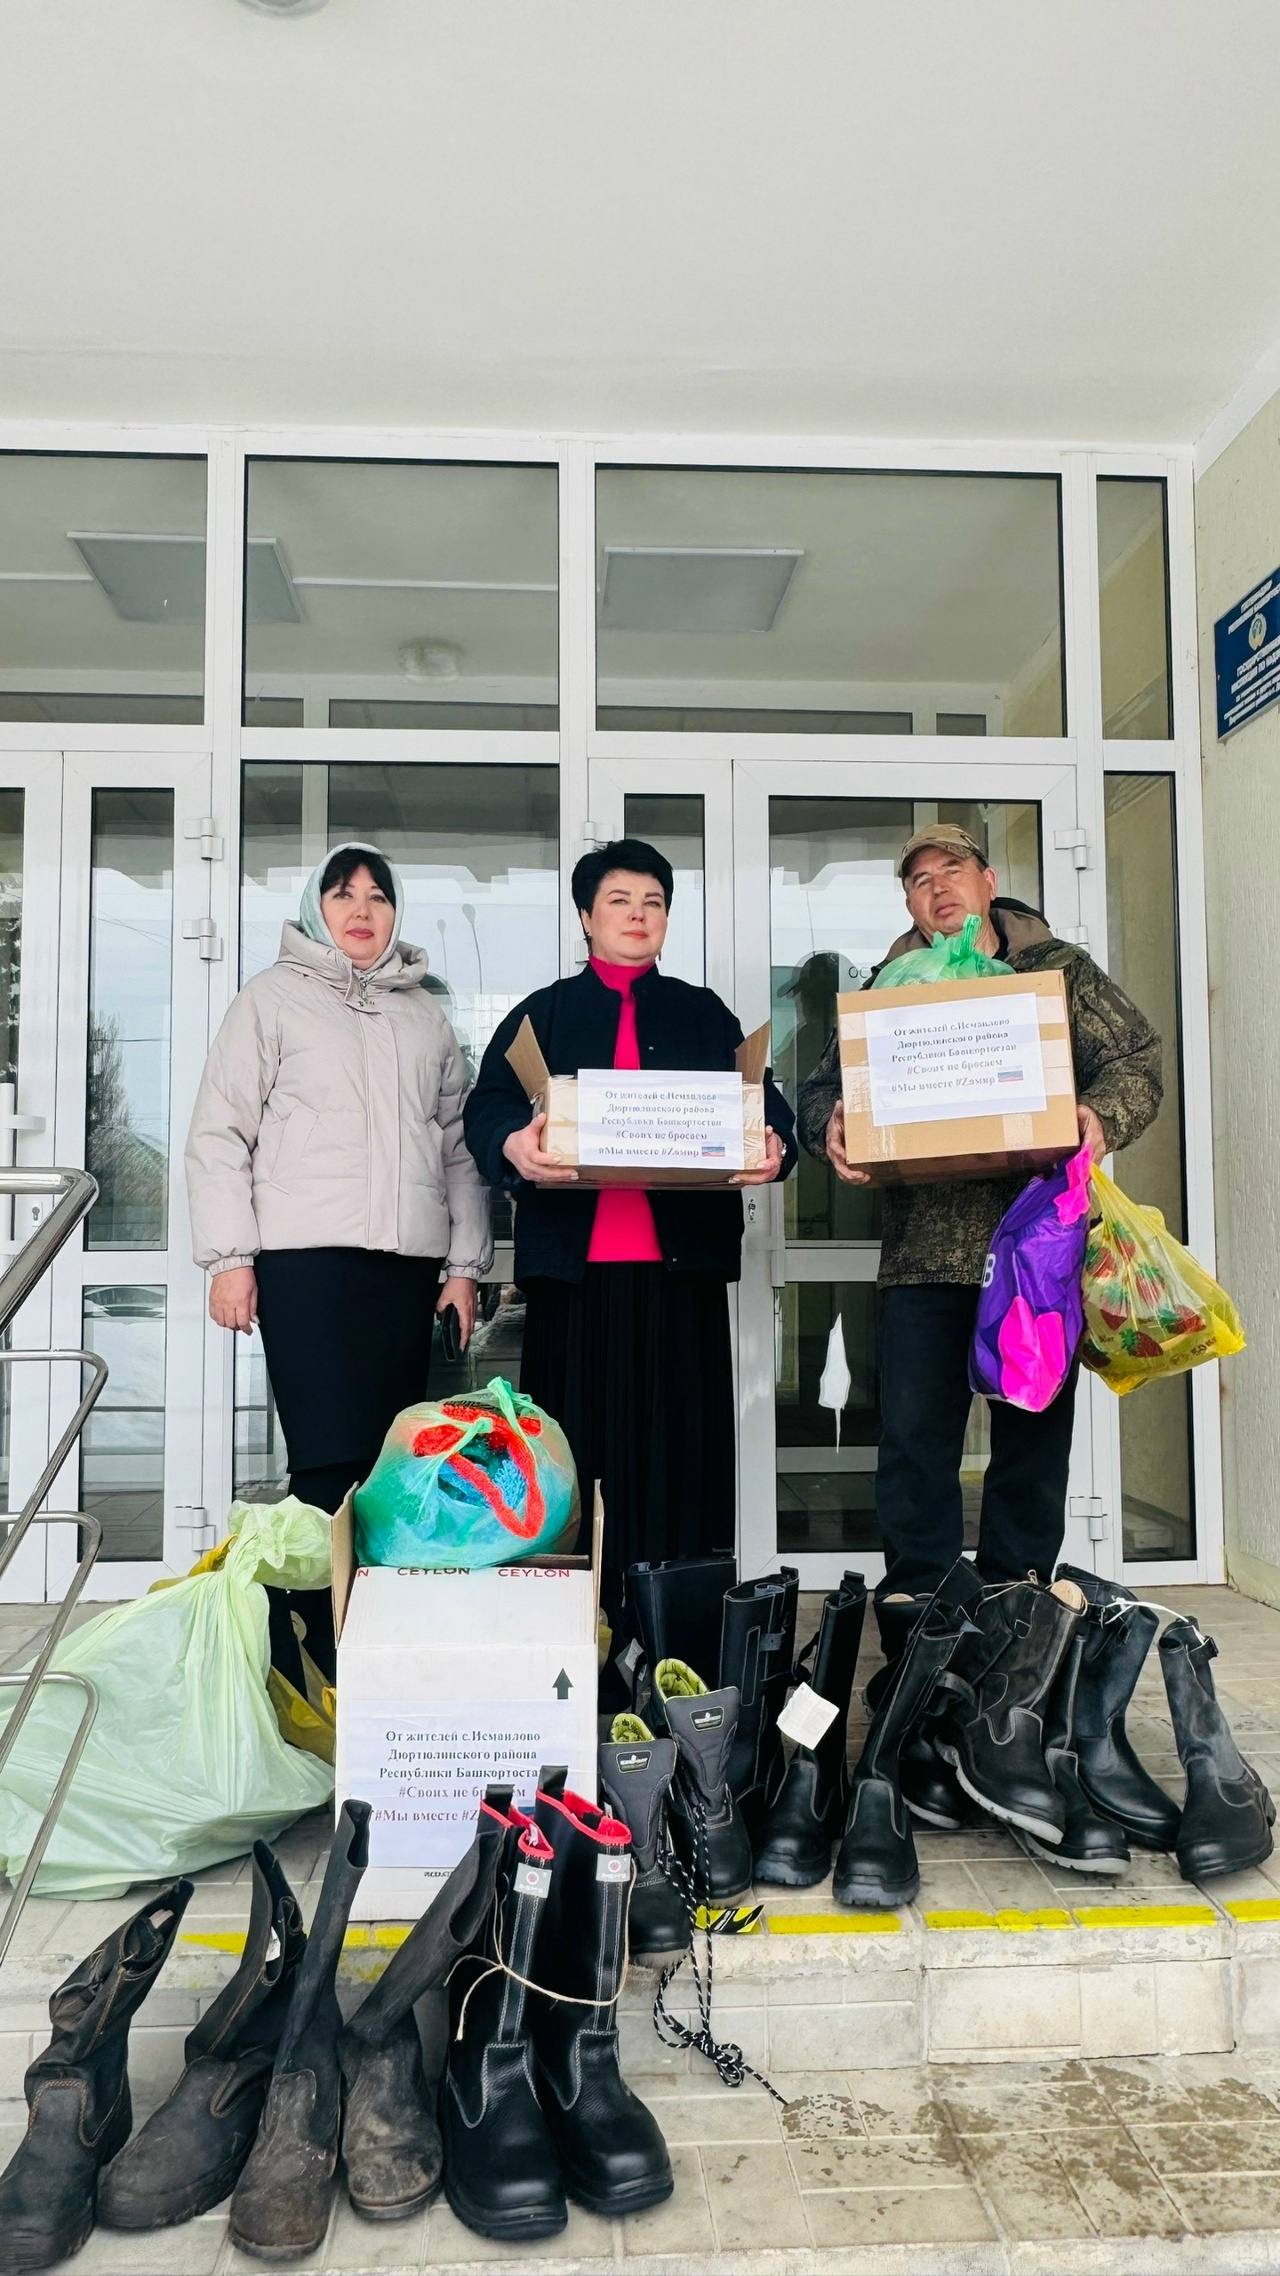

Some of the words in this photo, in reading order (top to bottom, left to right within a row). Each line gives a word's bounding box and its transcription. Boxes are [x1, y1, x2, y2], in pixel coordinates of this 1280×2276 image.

[893, 1028, 906, 1036] От
[908, 1025, 948, 1035] жителей
[897, 1036, 973, 1050] Дюртюлинского
[975, 1032, 1009, 1044] района
[907, 1065, 945, 1075] #Своих
[947, 1064, 959, 1072] не
[961, 1059, 1003, 1072] бросаем
[891, 1085, 917, 1093] #Мы
[919, 1081, 954, 1090] вместе
[605, 1091, 618, 1100] От
[620, 1092, 658, 1100] жителей
[606, 1104, 682, 1114] Дюртюлинского
[683, 1106, 715, 1114] района
[601, 1117, 654, 1128] Республики
[656, 1118, 722, 1128] Башкортостан
[615, 1132, 652, 1140] #Своих
[668, 1132, 707, 1142] бросаем
[598, 1147, 624, 1156] #Мы
[626, 1149, 659, 1157] вместе
[498, 1568, 571, 1579] CEYLON
[386, 1731, 403, 1742] От
[405, 1730, 458, 1742] жителей
[461, 1730, 541, 1742] с.Исмаилово
[387, 1749, 491, 1763] Дюртюлинского
[493, 1749, 537, 1762] района
[379, 1767, 452, 1780] Республики
[456, 1767, 538, 1780] Башкортоста
[399, 1786, 449, 1798] #Своих
[453, 1788, 469, 1798] не
[375, 1809, 408, 1821] #Мы
[412, 1811, 459, 1821] вместе
